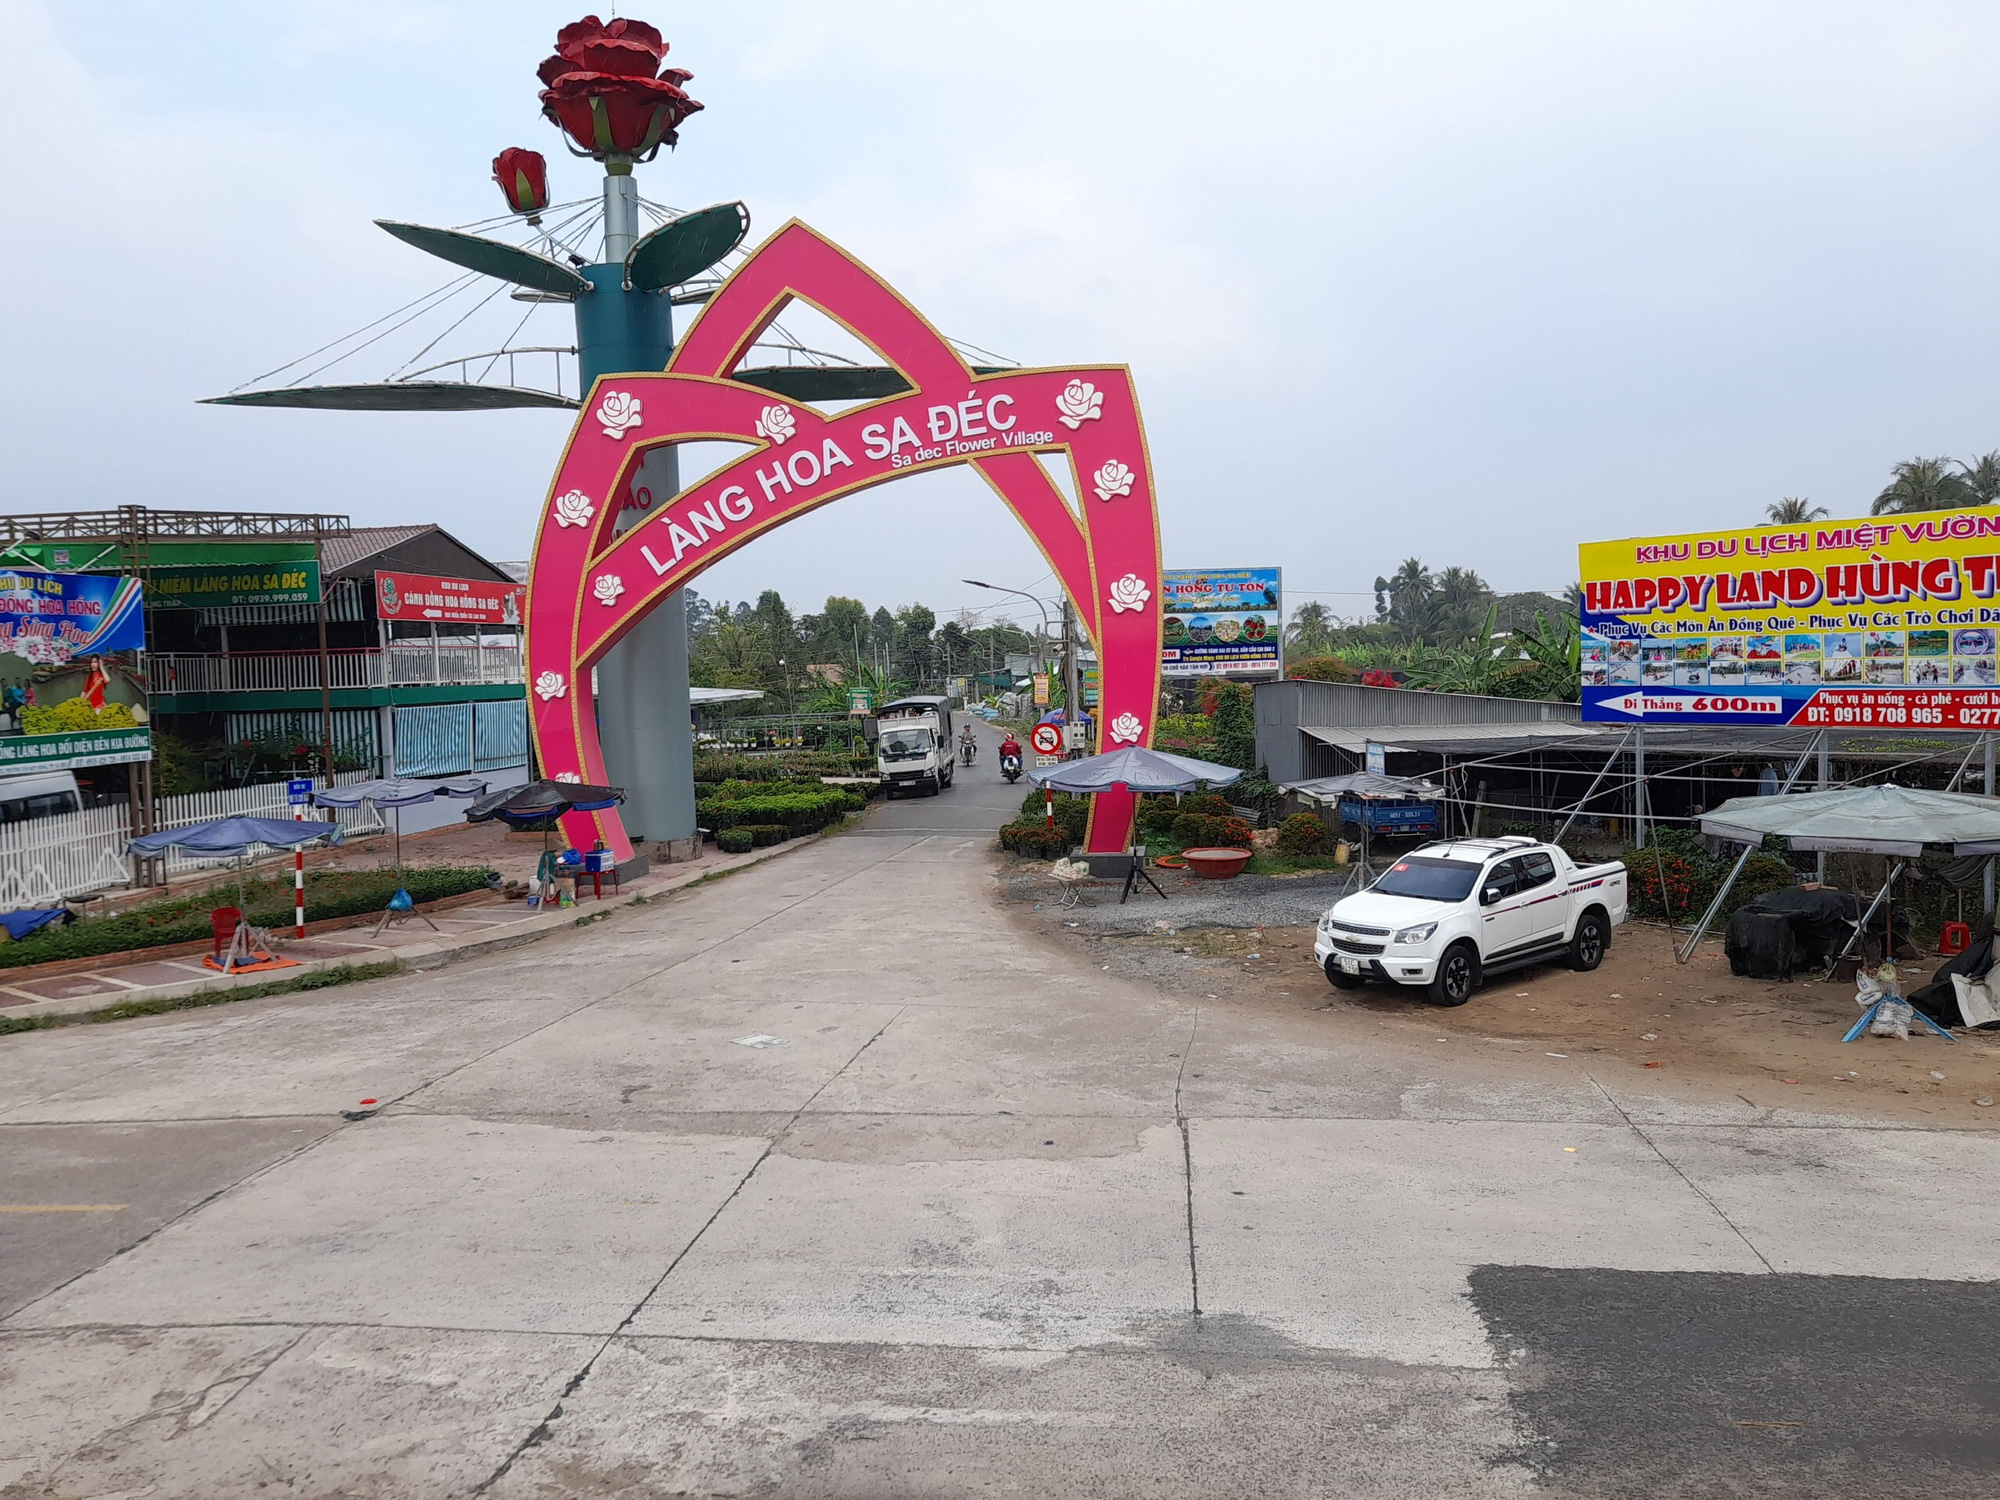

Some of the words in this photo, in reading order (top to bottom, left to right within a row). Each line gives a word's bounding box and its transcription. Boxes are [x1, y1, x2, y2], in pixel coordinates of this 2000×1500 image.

[891, 453, 912, 468] Sa
[914, 447, 942, 462] dec
[946, 436, 997, 456] Flower
[1002, 429, 1054, 447] Village
[640, 485, 754, 576] LÀNG
[755, 437, 854, 502] HOA
[861, 415, 922, 460] SA
[927, 389, 1017, 442] ĐÉC
[1636, 543, 1690, 562] KHU
[1697, 538, 1737, 559] DU
[1744, 532, 1808, 559] LỊCH
[1816, 523, 1896, 550] MIỆT
[1900, 514, 2000, 543] VƯỜN
[18, 576, 34, 589] DU
[37, 578, 63, 595] LỊCH
[160, 574, 191, 597] NIỆM
[194, 572, 228, 592] LÀNG
[232, 575, 260, 591] HOA
[262, 574, 278, 590] SA
[282, 568, 307, 589] ĐÉC
[1585, 574, 1712, 614] HAPPY
[1716, 567, 1821, 608] LAND
[1825, 553, 1959, 602] HÙNG
[1963, 555, 2000, 597] T
[38, 600, 65, 615] HOA
[67, 594, 101, 615] HỒNG
[248, 593, 308, 604] 0939.999.059
[404, 590, 424, 605] CÁNH
[445, 595, 459, 608] HOA
[478, 598, 487, 610] SA
[59, 620, 92, 645] Hoa
[1600, 622, 1628, 640] Phục
[1630, 623, 1647, 638] Vụ
[1651, 621, 1672, 634] Các
[1676, 619, 1703, 633] Món
[1708, 616, 1724, 632] Ăn
[1729, 617, 1763, 633] Đồng
[1767, 617, 1796, 631] Quê
[1809, 615, 1843, 631] Phục
[1848, 613, 1867, 630] Vụ
[1873, 612, 1899, 626] Các
[1905, 611, 1931, 625] Trò
[1937, 608, 1974, 623] Chơi
[1624, 698, 1637, 709] Đi
[1641, 697, 1683, 711] Thẳng
[1692, 697, 1776, 711] 600m
[1819, 692, 1843, 706] Phục
[1847, 695, 1858, 706] vụ
[1862, 693, 1875, 704] ăn
[1878, 691, 1905, 706] uống
[1915, 693, 1928, 704] cà
[1931, 692, 1952, 706] phê
[1963, 692, 1988, 704] cưới
[1808, 707, 1830, 722] ĐT:
[1834, 707, 1872, 723] 0918
[1876, 708, 1907, 723] 708
[1911, 708, 1942, 724] 965
[17, 742, 39, 758] LÀNG
[40, 744, 57, 756] HOA
[111, 738, 123, 749] KIA
